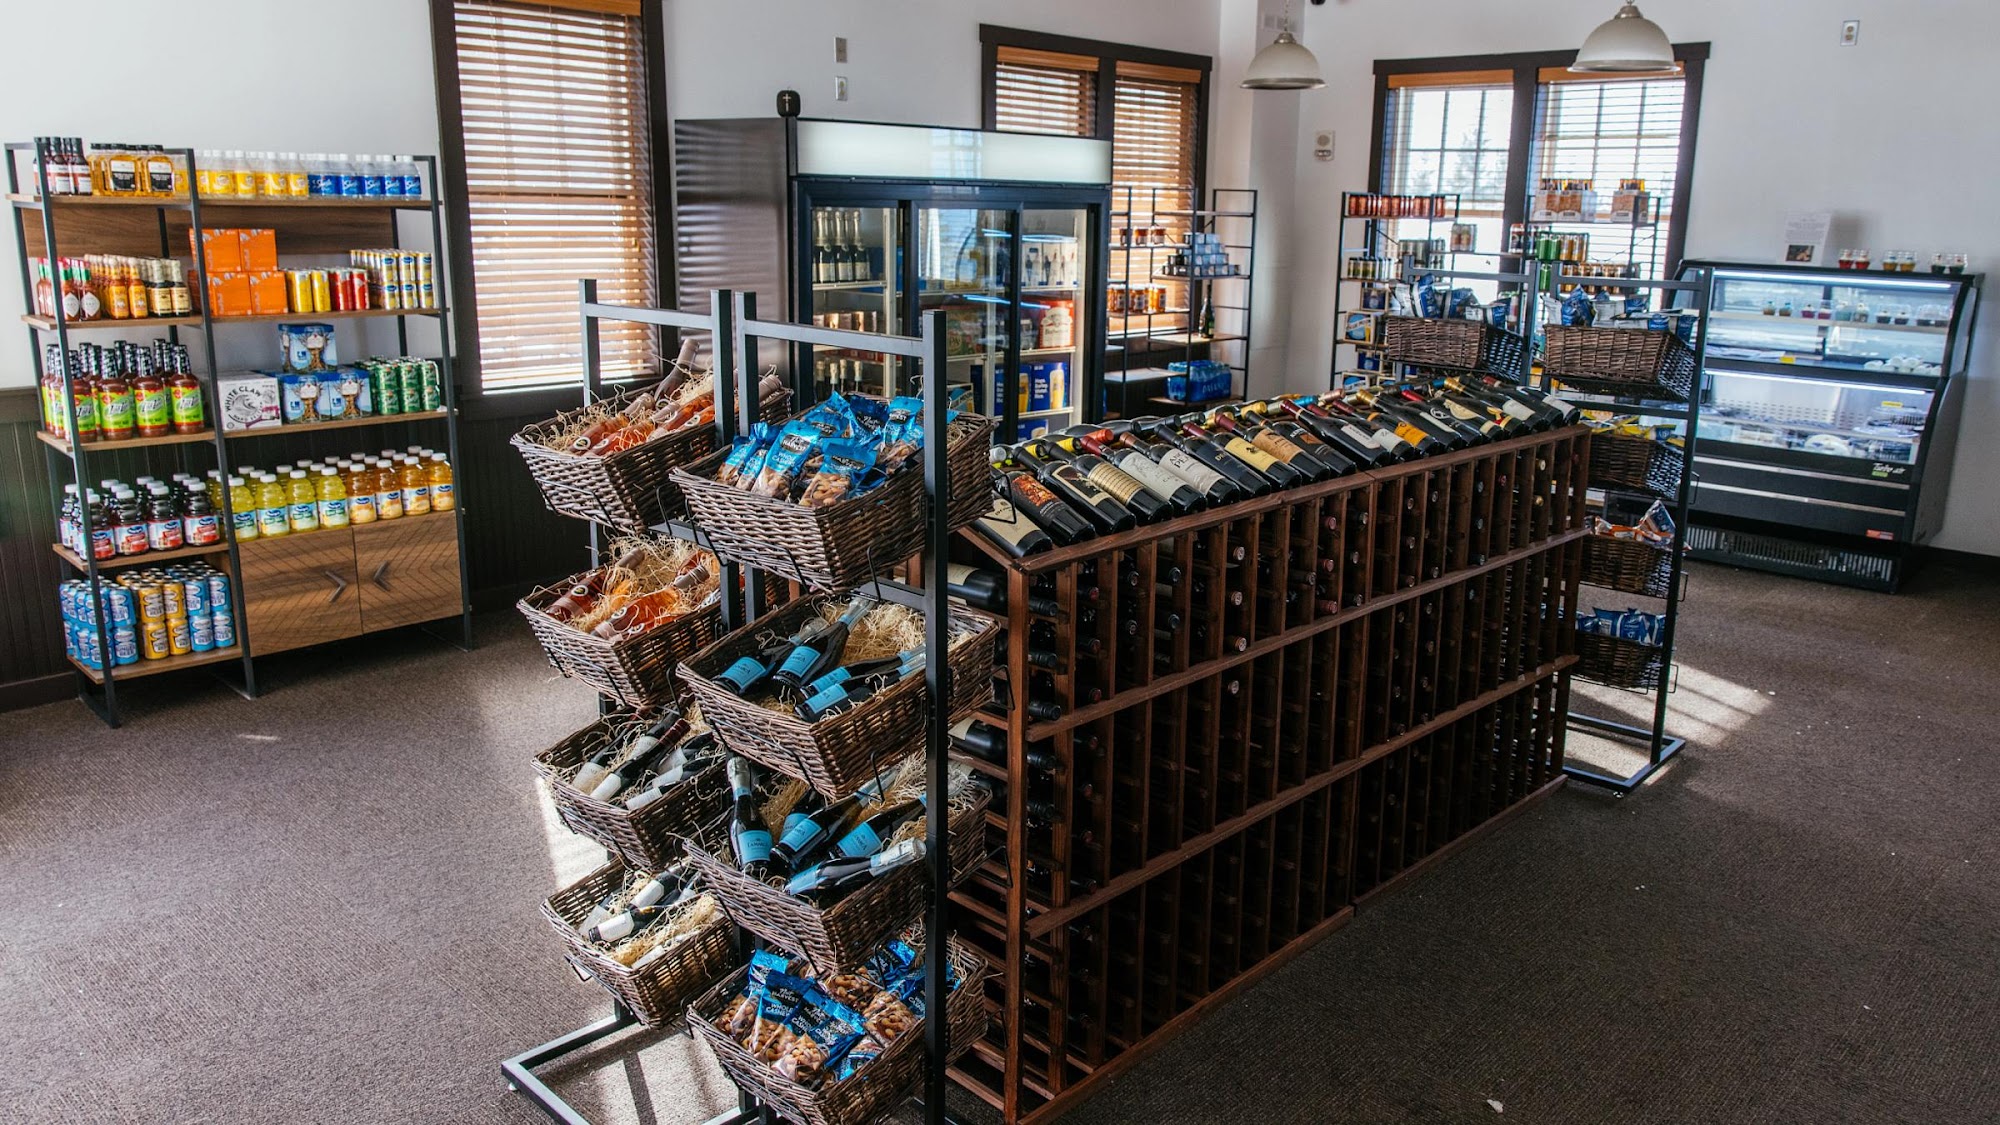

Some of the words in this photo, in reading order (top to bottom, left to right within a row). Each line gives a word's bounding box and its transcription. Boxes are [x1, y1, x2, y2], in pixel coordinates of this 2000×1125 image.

[225, 388, 239, 412] WHITE
[238, 385, 262, 397] CLAW
[771, 991, 799, 1002] HARVEST
[771, 1002, 794, 1012] WHOLE
